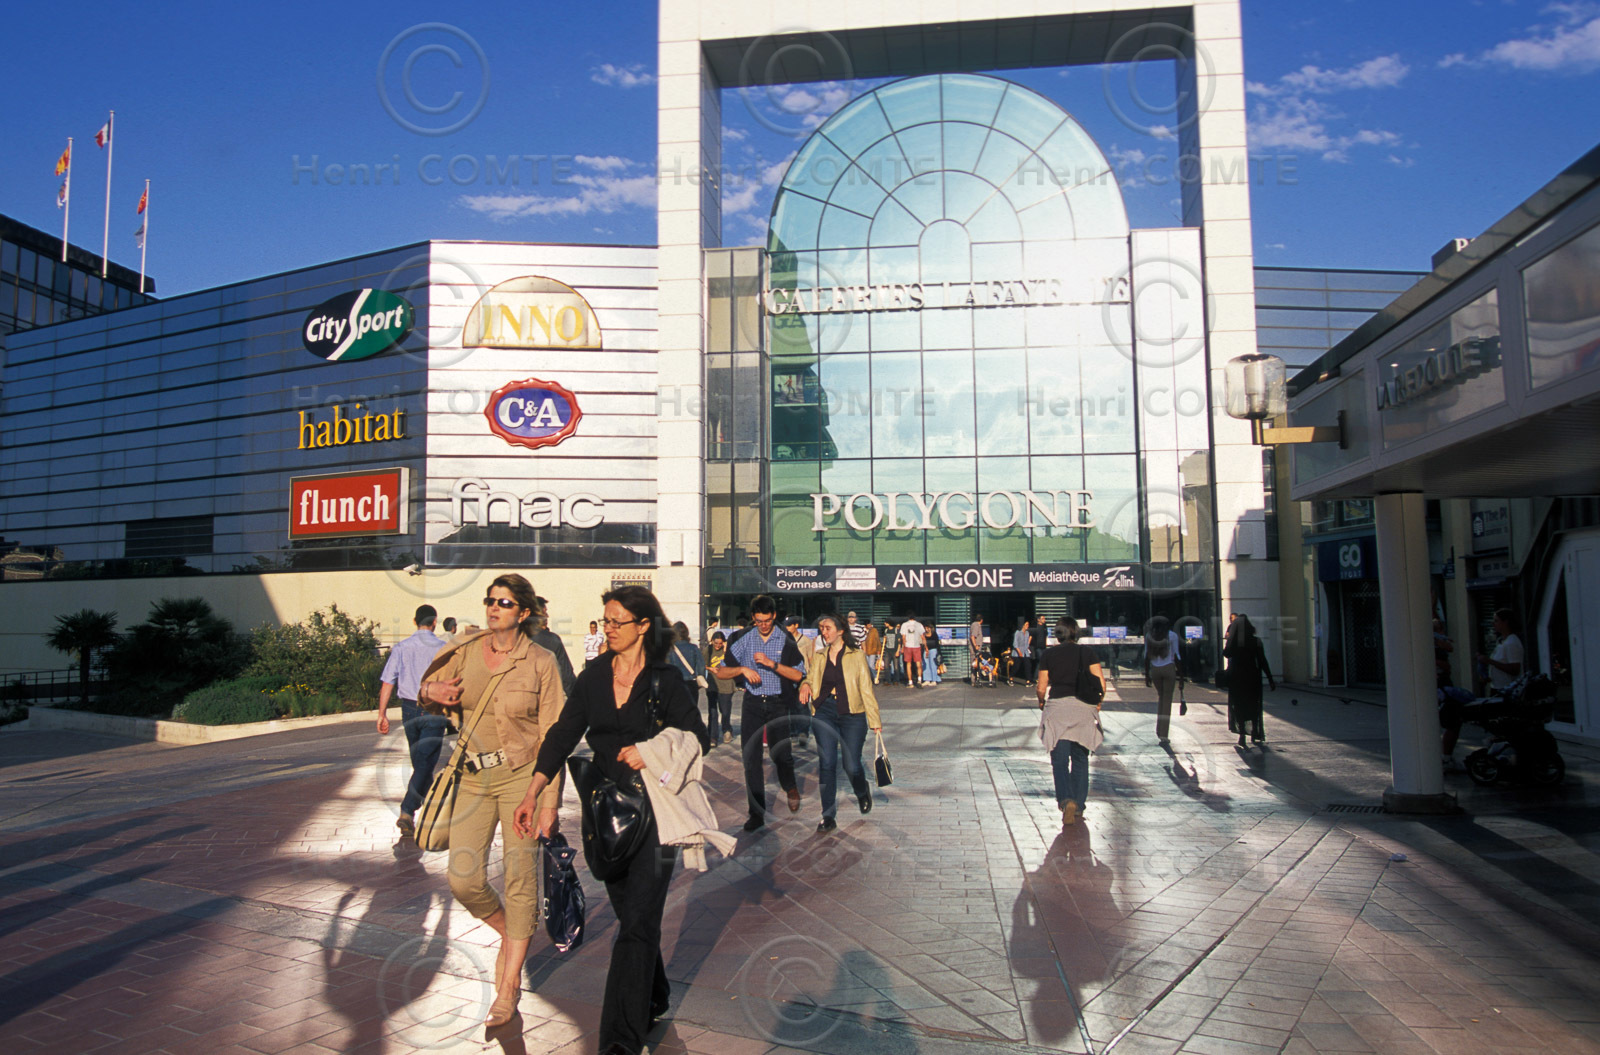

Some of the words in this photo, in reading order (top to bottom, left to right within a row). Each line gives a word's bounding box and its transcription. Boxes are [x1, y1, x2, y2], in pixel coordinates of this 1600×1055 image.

[943, 275, 1129, 309] LAFAYETE
[306, 313, 345, 343] City
[327, 288, 403, 361] Sport
[483, 304, 583, 341] INNO
[297, 404, 405, 450] habitat
[499, 396, 565, 429] C&A
[299, 485, 390, 526] flunch
[449, 477, 605, 529] fnac
[810, 489, 1097, 532] POLYGONE
[1339, 543, 1361, 568] GO
[776, 569, 818, 577] Piscine
[776, 580, 832, 589] Gymnase
[892, 568, 1013, 588] ANTIGONE
[1029, 570, 1100, 584] Médiathèque
[1102, 566, 1135, 588] Fellini
